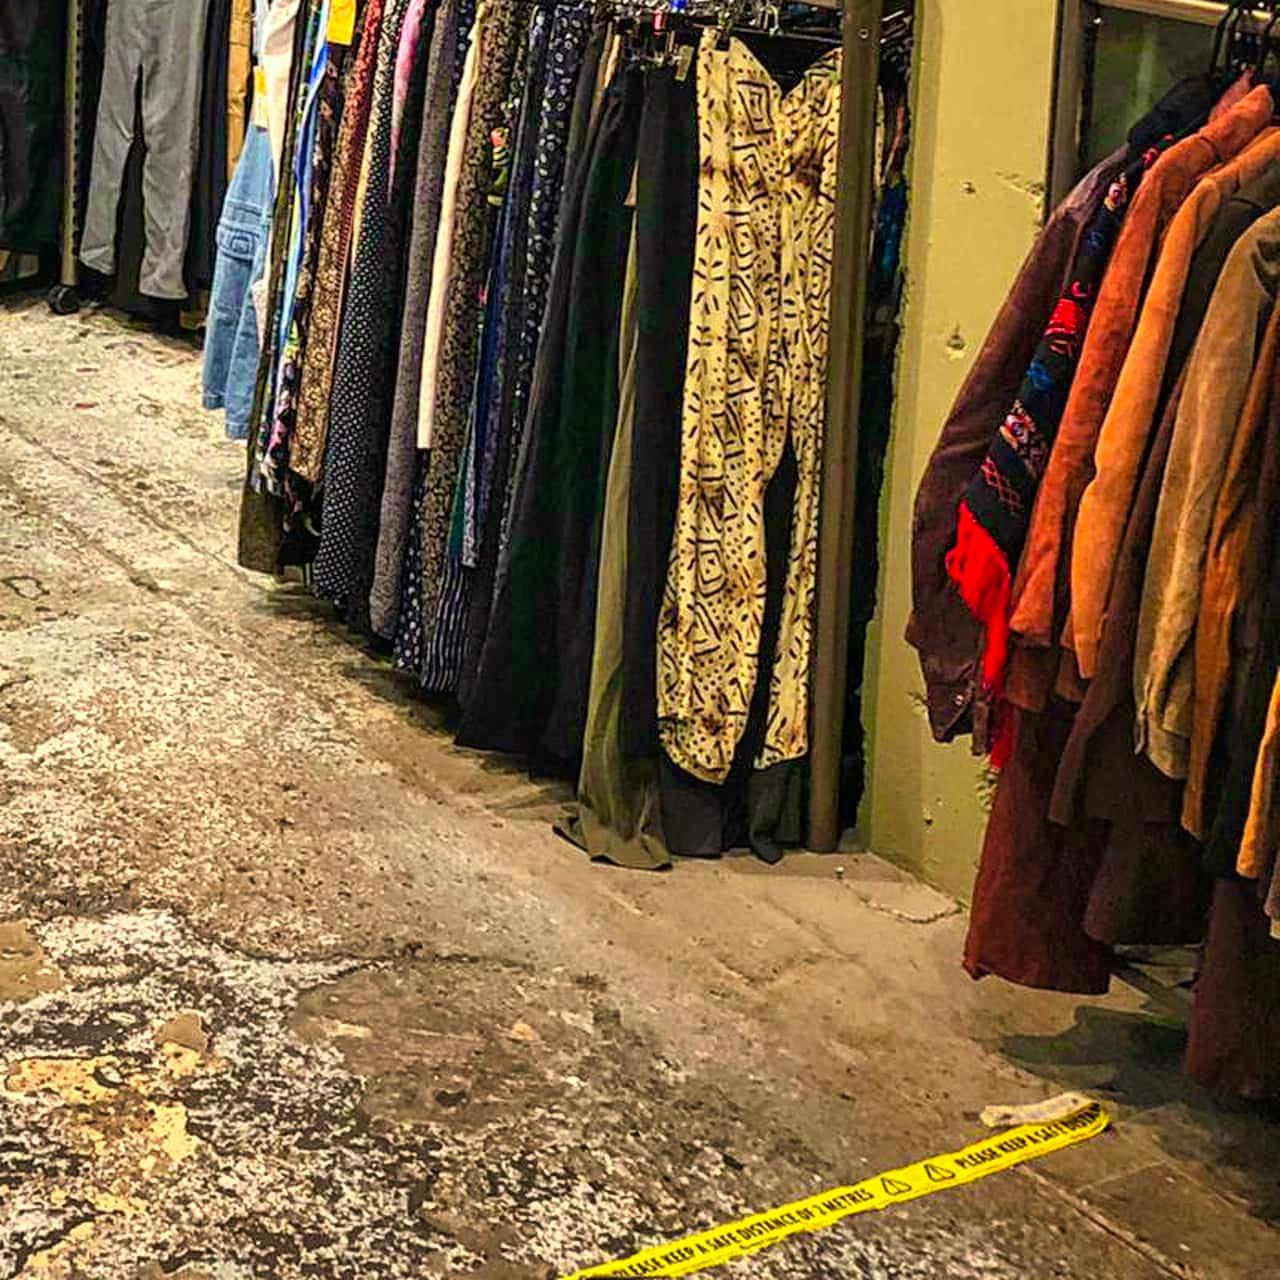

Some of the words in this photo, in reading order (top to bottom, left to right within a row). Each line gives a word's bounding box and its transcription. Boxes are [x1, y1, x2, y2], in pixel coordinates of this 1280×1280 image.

[954, 1146, 1003, 1169] PLEASE
[997, 1135, 1029, 1154] KEEP
[1026, 1134, 1039, 1145] A
[1034, 1120, 1070, 1142] SAFE
[613, 1255, 668, 1277] PLEASE
[663, 1245, 695, 1268] KEEP
[694, 1242, 708, 1257] A
[704, 1231, 741, 1252] SAFE
[734, 1211, 800, 1241] DISTANCE
[796, 1206, 817, 1222] OF
[812, 1203, 827, 1217] 2
[821, 1187, 876, 1216] METRES
